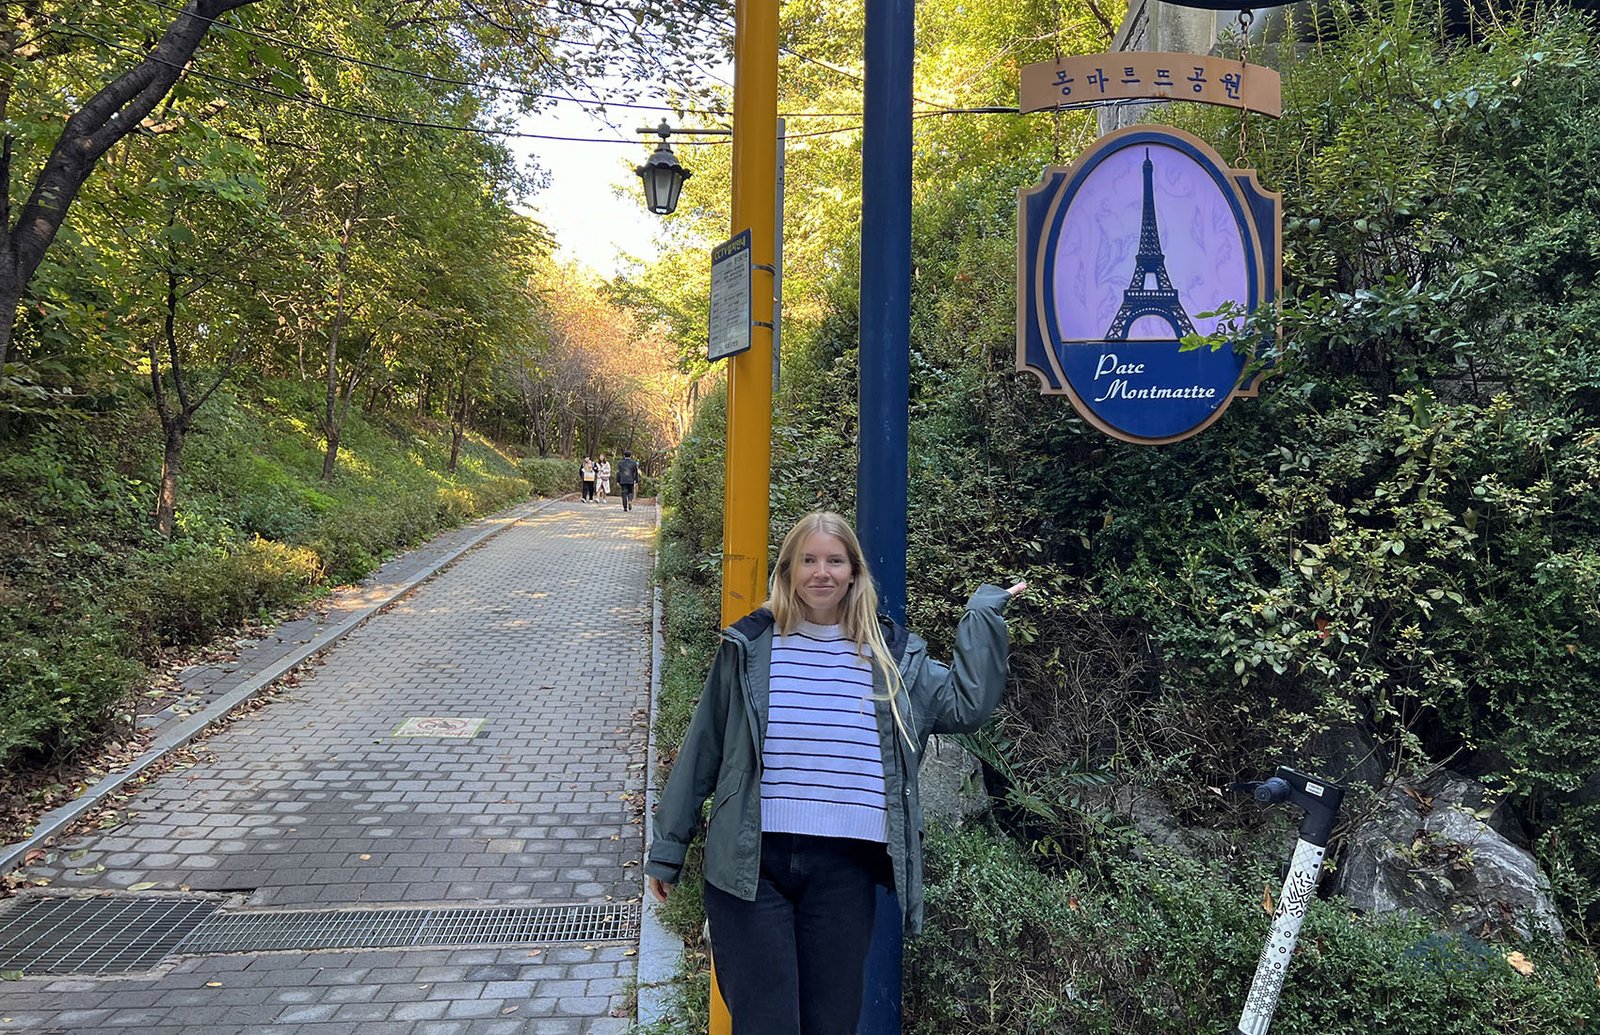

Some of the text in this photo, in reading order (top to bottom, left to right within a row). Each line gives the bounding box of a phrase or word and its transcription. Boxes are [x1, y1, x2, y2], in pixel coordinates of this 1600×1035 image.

[1052, 67, 1242, 99] 몽마르뜨공원
[1094, 353, 1145, 381] Parc
[1094, 378, 1216, 403] Montmartre
